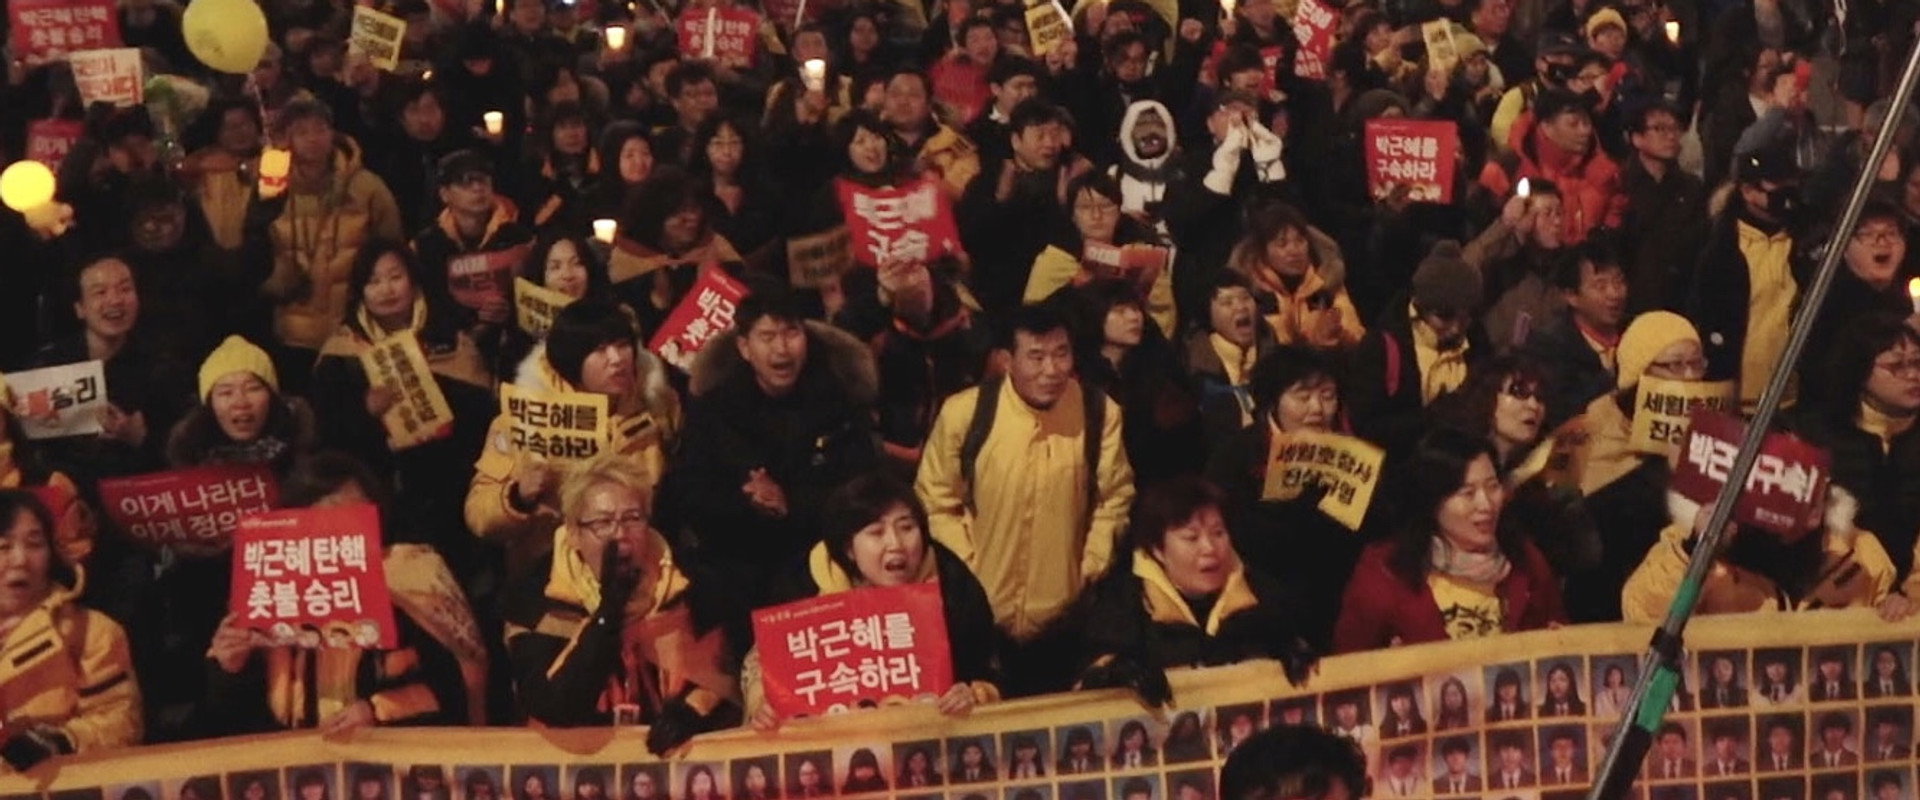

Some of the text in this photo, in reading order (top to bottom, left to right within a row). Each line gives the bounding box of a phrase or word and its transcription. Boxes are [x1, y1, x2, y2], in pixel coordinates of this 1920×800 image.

[1375, 135, 1438, 159] 박근혜를
[1376, 159, 1436, 182] 구속하라
[508, 397, 598, 432] 박근혜를
[510, 426, 600, 460] 구속하라
[1688, 431, 1819, 504] 박근구속!
[120, 475, 267, 518] 이게 나라다
[131, 518, 188, 542] 이게
[244, 534, 367, 578] 박근혜 탄핵
[247, 576, 362, 620] 촛불 승리
[787, 612, 916, 663] 박근혜를
[794, 653, 922, 706] 구속하라
